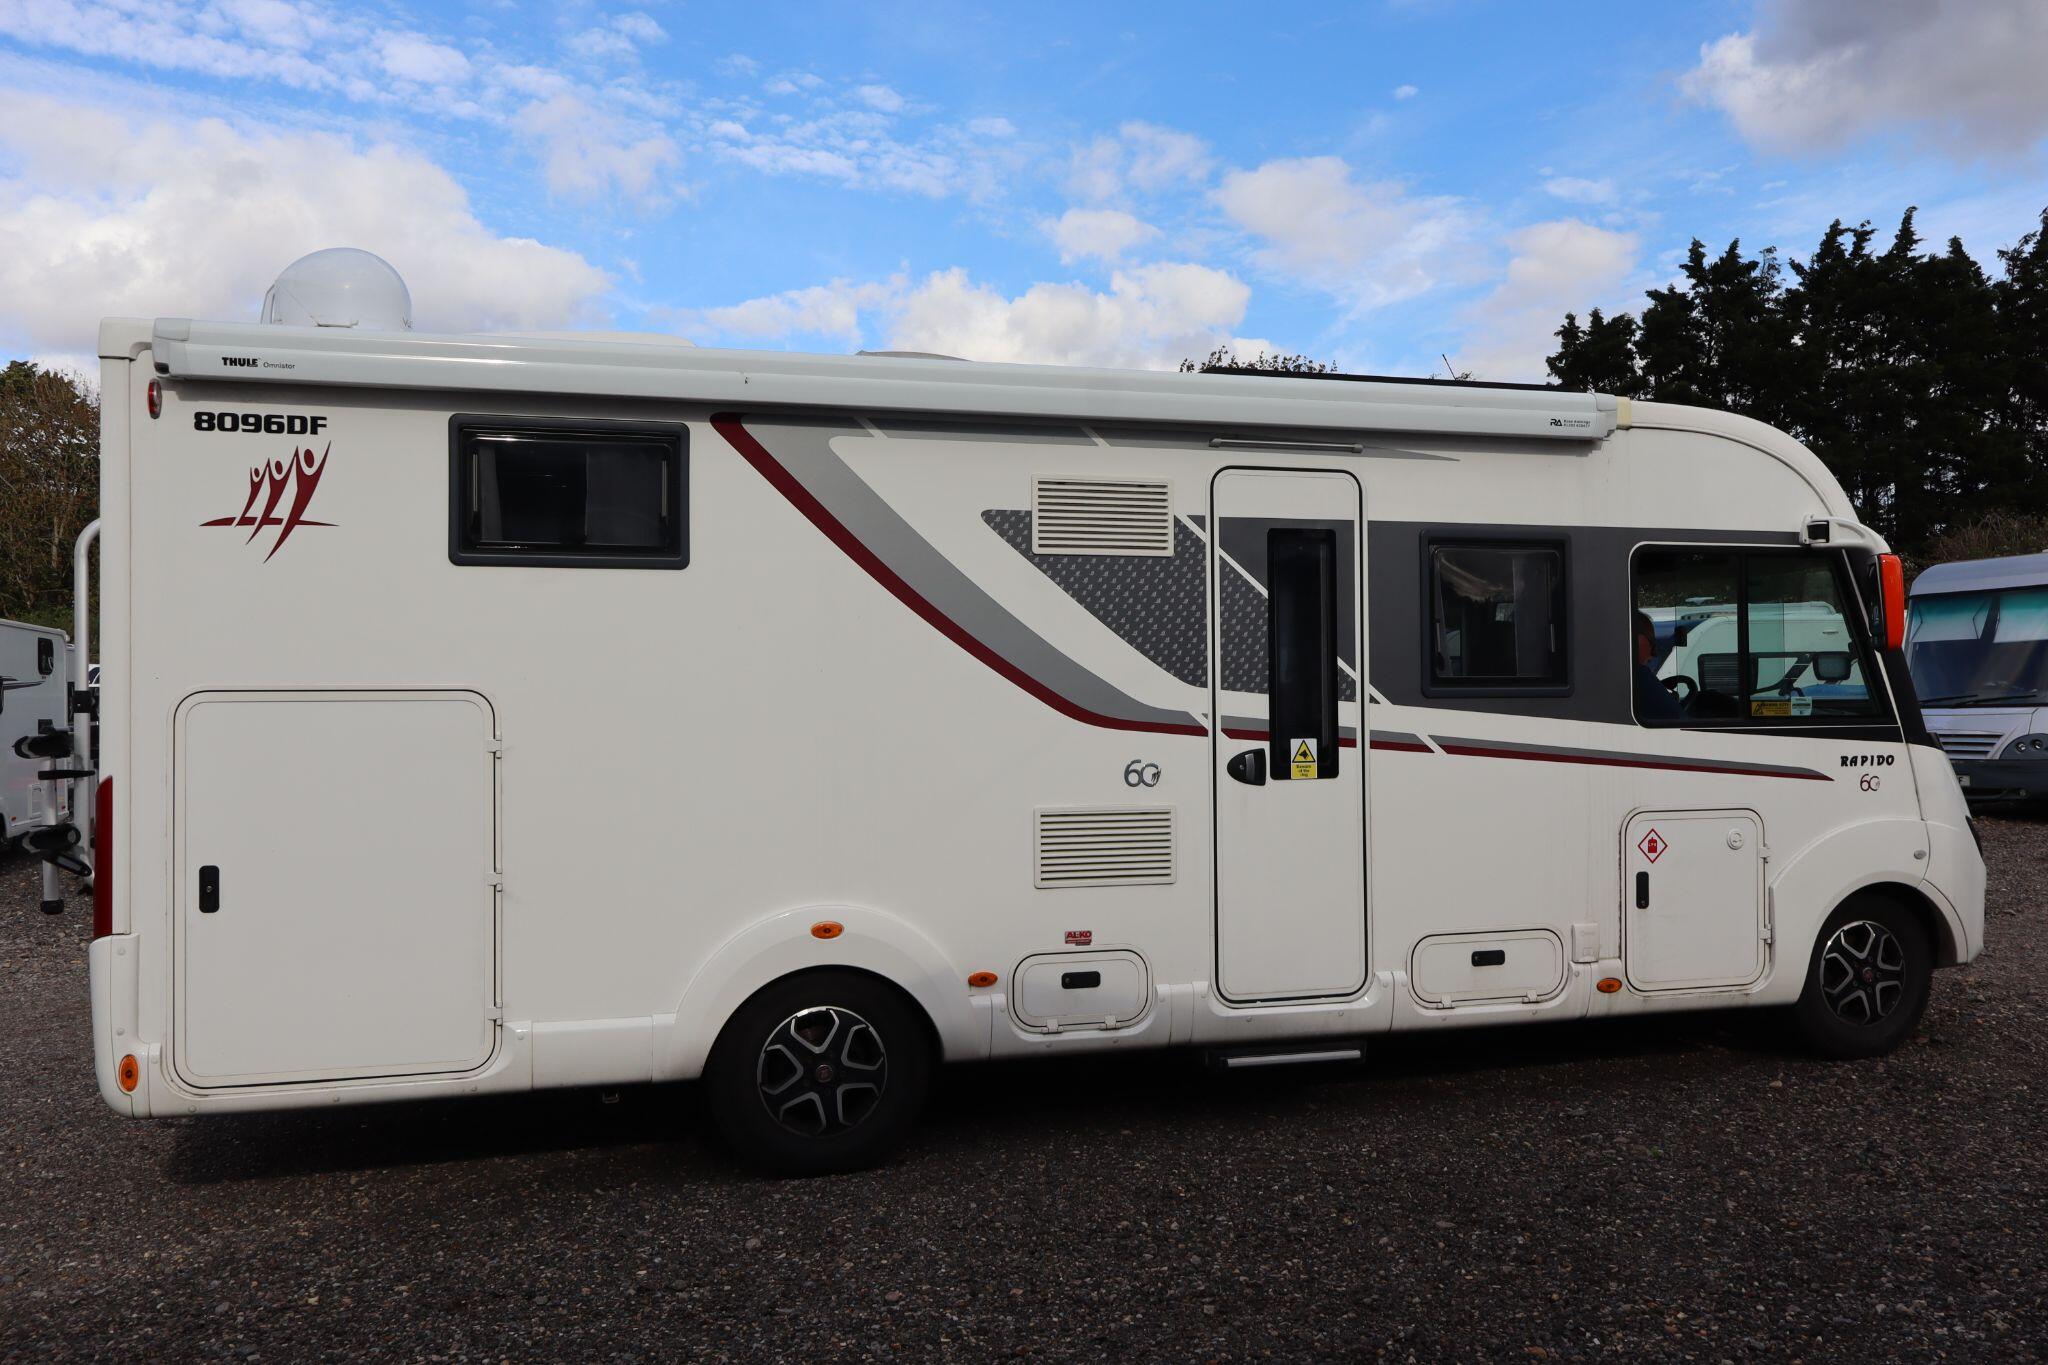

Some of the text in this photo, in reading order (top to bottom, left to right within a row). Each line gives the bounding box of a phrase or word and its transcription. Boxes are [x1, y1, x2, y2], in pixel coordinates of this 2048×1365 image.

[222, 356, 296, 370] THULE Omnistor
[194, 411, 328, 435] 8096DF
[1840, 754, 1895, 767] RAPIDO
